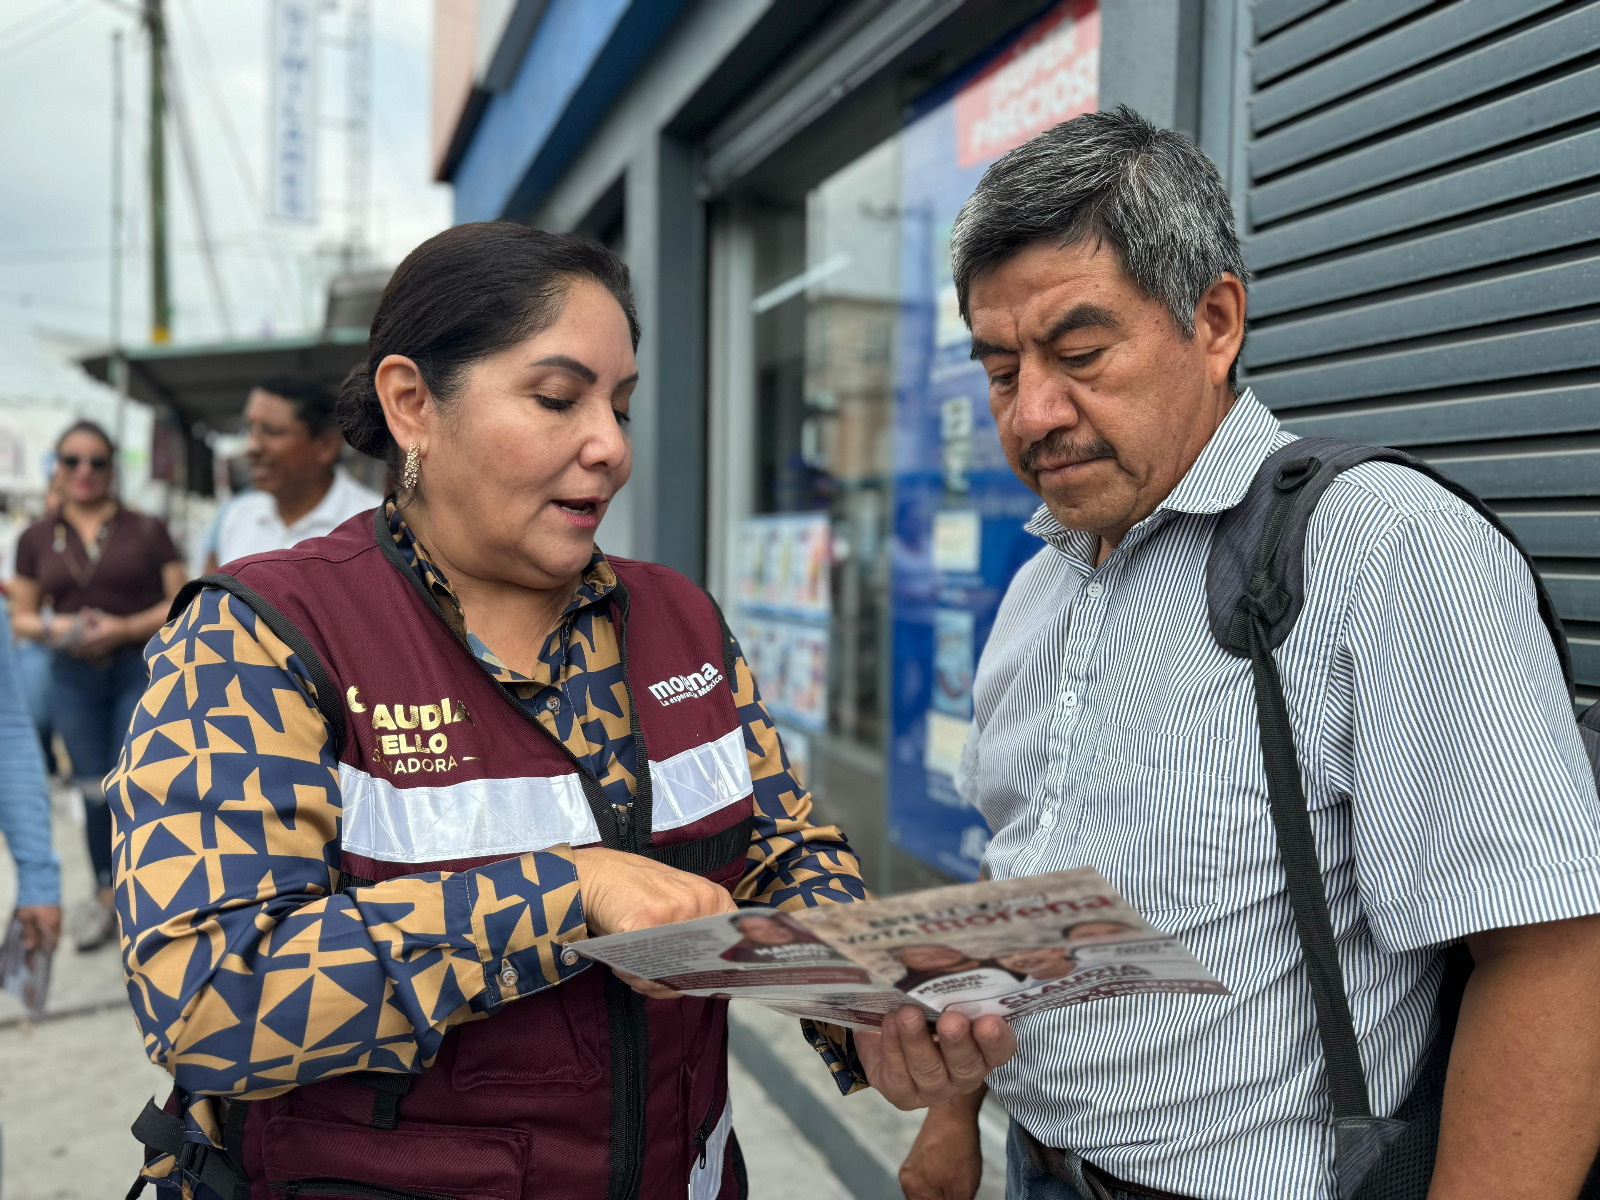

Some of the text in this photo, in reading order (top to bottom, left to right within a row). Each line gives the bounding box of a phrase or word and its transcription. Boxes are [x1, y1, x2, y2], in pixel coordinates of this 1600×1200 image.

[346, 684, 476, 731] CAUDIA
[917, 974, 989, 995] MANUEL
[998, 964, 1147, 1005] CLAUDIA
